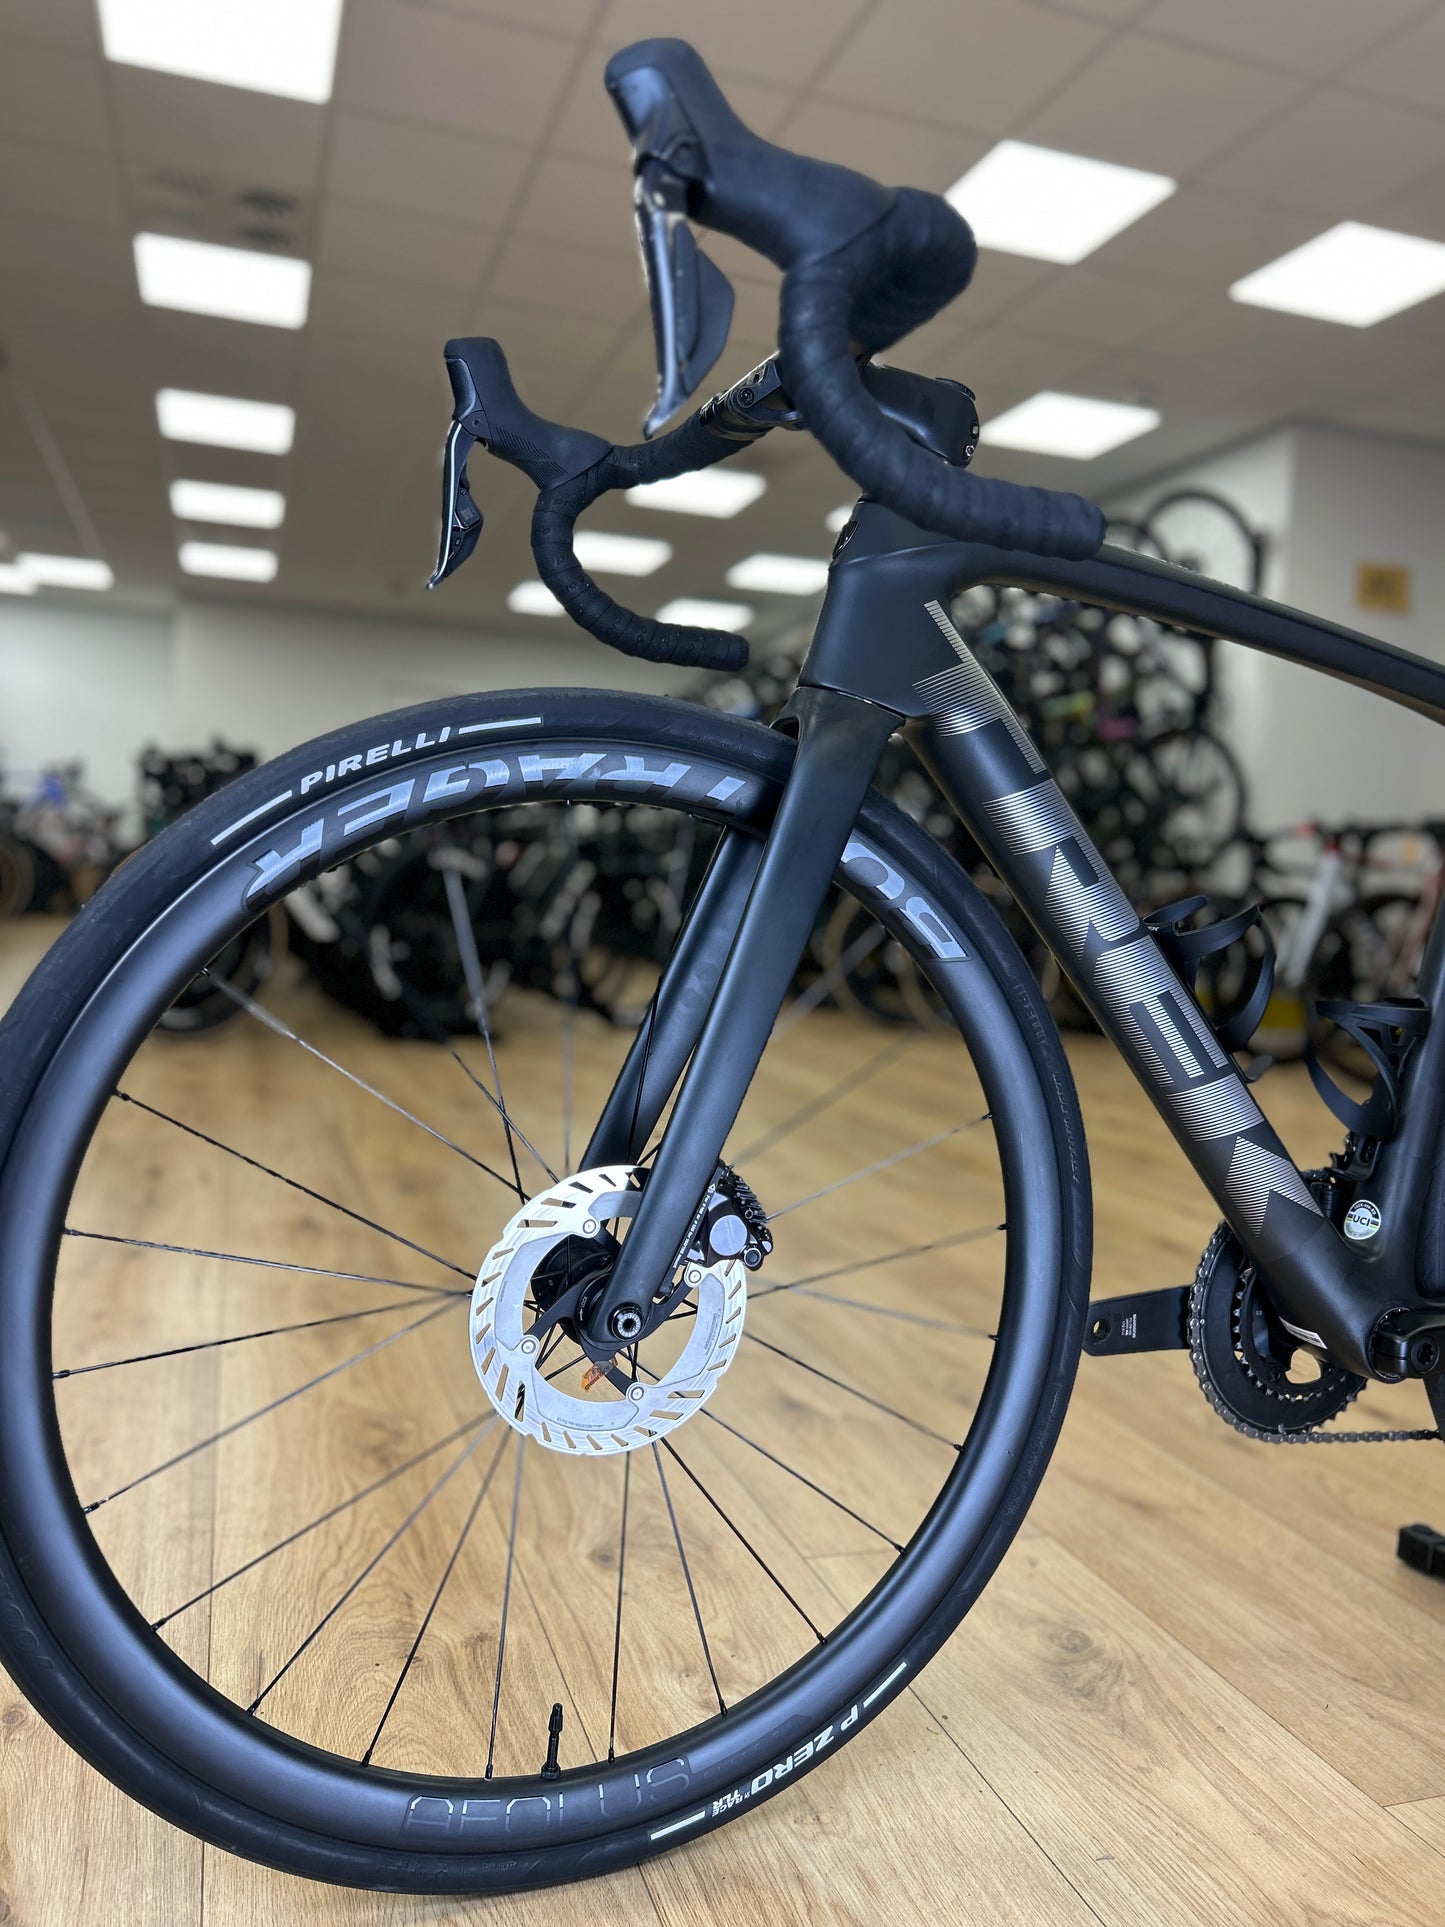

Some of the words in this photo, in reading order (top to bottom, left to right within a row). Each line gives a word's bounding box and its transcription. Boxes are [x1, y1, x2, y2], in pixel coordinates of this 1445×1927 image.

[300, 726, 451, 794] PIRELLI
[246, 753, 968, 959] BOTRAGER
[912, 601, 1324, 1237] TREK
[1353, 1215, 1371, 1227] UCI
[840, 1704, 859, 1731] P
[751, 1725, 834, 1795] ZERO
[404, 1757, 690, 1832] AEOLUS
[712, 1789, 740, 1808] TLR
[712, 1796, 743, 1817] RACE
